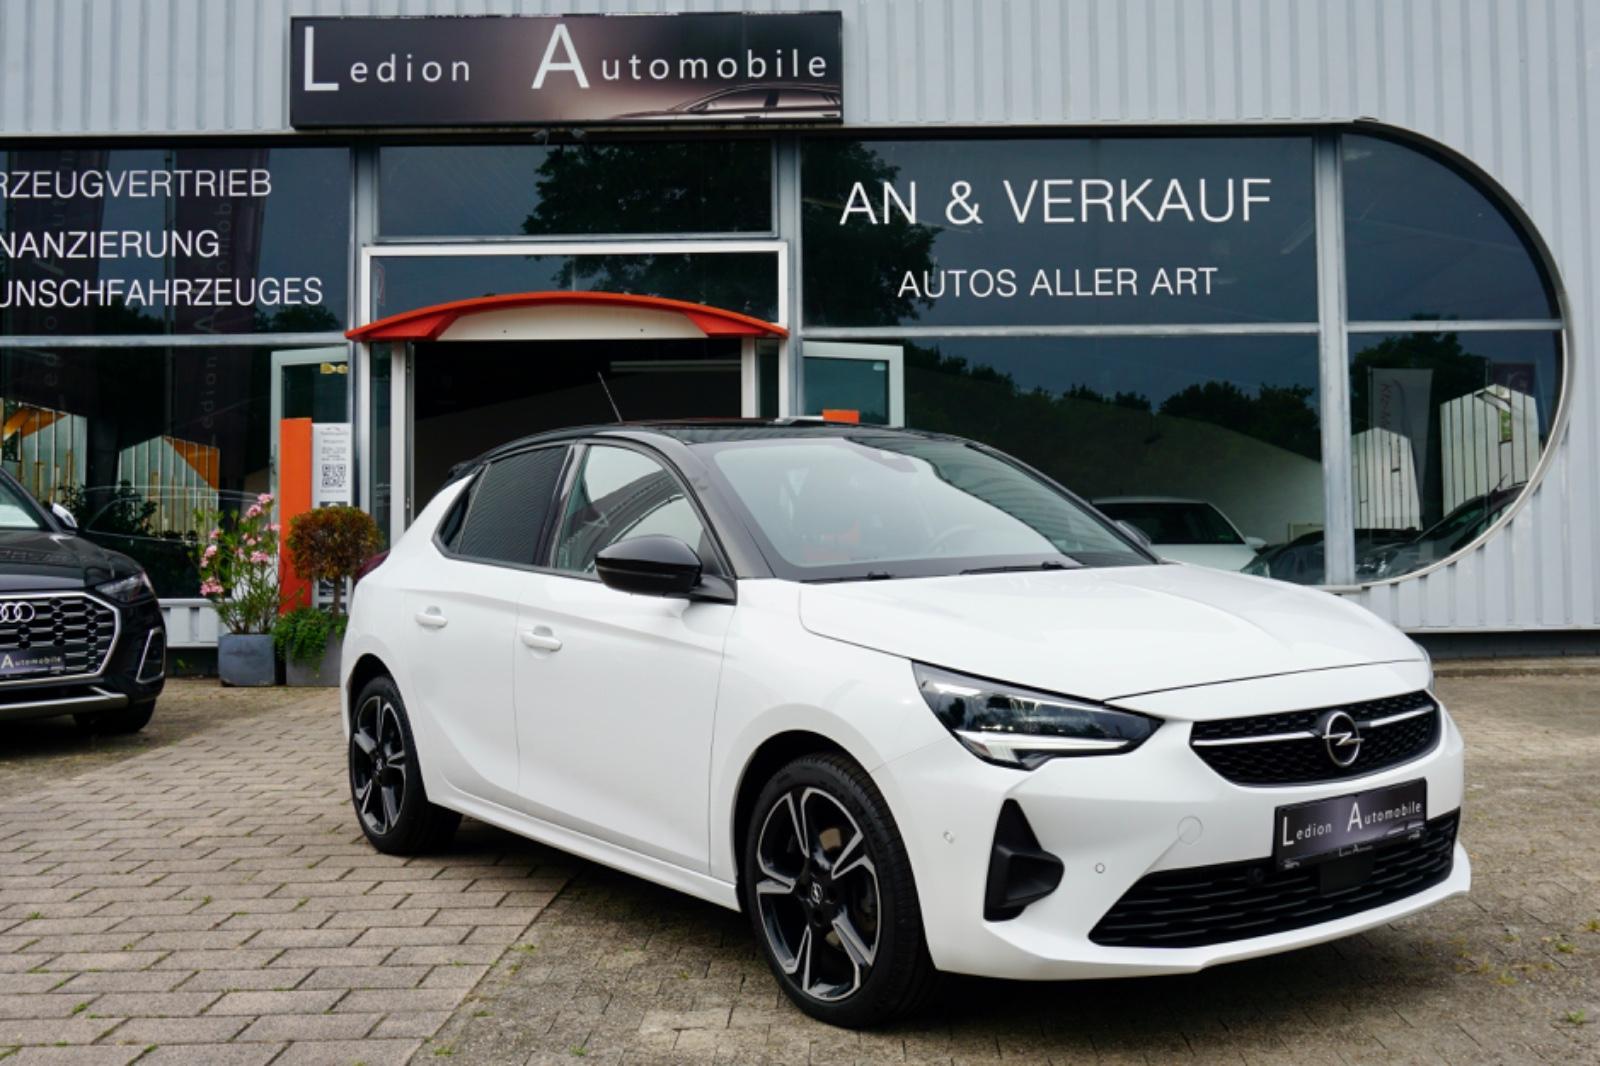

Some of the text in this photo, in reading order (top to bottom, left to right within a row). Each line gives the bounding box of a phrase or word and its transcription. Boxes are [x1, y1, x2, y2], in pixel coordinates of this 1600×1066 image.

[304, 23, 828, 92] Ledion Automobile
[839, 178, 1271, 226] AN & VERKAUF
[0, 230, 219, 259] NANZIERUNG
[0, 277, 323, 308] UNSCHFAHRZEUGES
[898, 267, 1219, 298] AUTOS ALLER ART
[1282, 801, 1421, 847] Ledion Automobile
